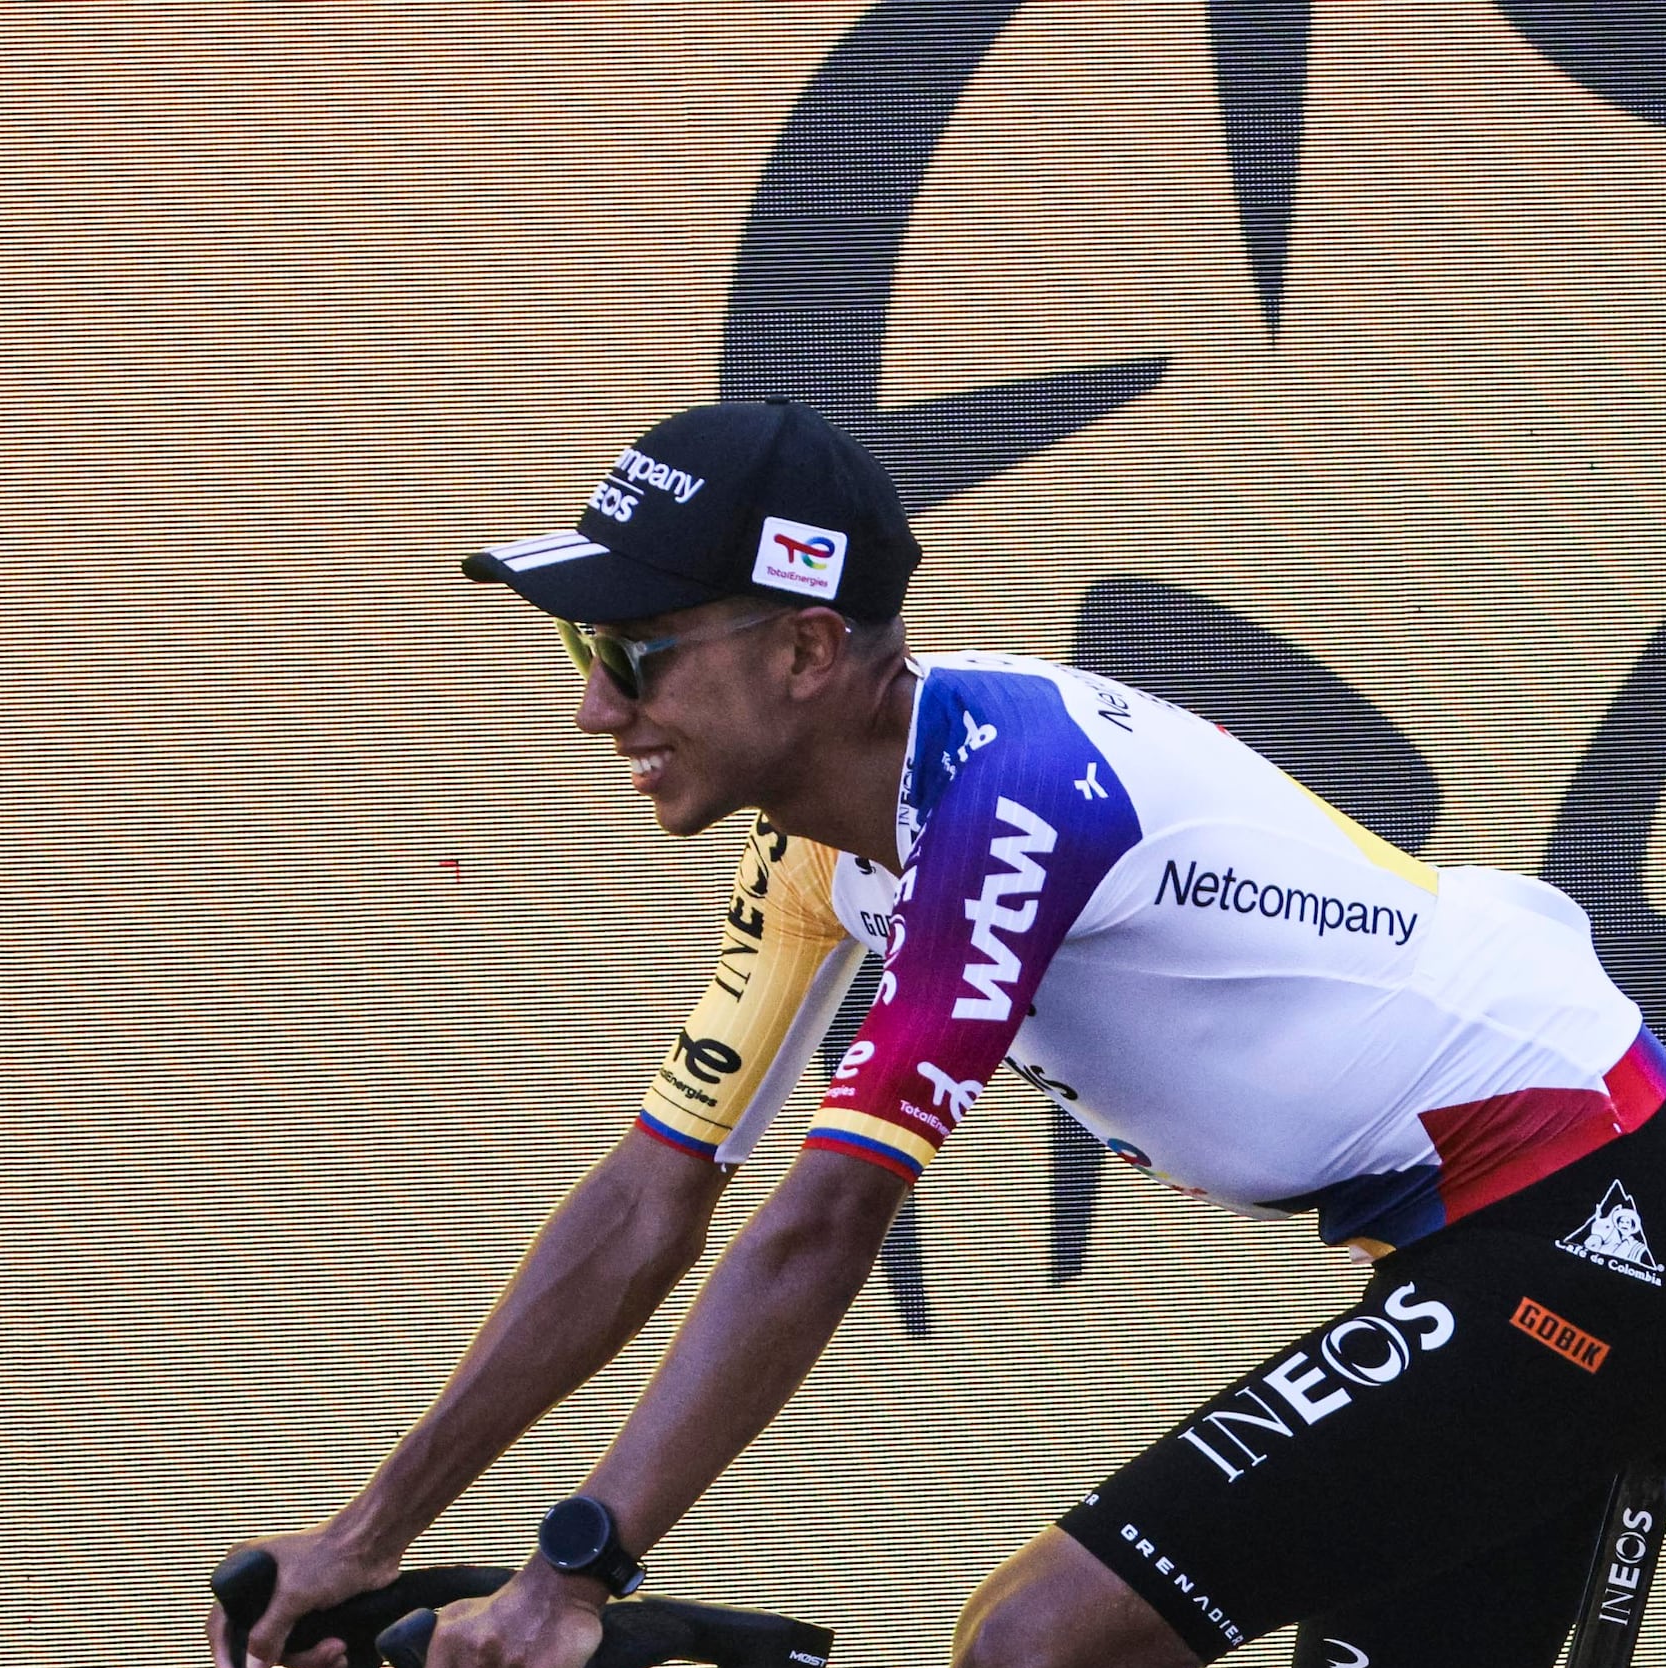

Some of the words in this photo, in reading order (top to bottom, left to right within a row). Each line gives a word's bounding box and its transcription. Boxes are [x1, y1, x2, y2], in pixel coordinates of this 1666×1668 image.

[766, 566, 829, 588] TotalEnergies
[950, 795, 1058, 1021] wtw
[1153, 859, 1419, 946] Netcompany
[1589, 1253, 1605, 1267] de
[1607, 1258, 1662, 1288] Colombia
[1177, 1280, 1457, 1484] INEOS
[1518, 1303, 1604, 1369] GOBIK
[1119, 1523, 1245, 1648] GRENADIER
[1598, 1506, 1653, 1626] INEOS
